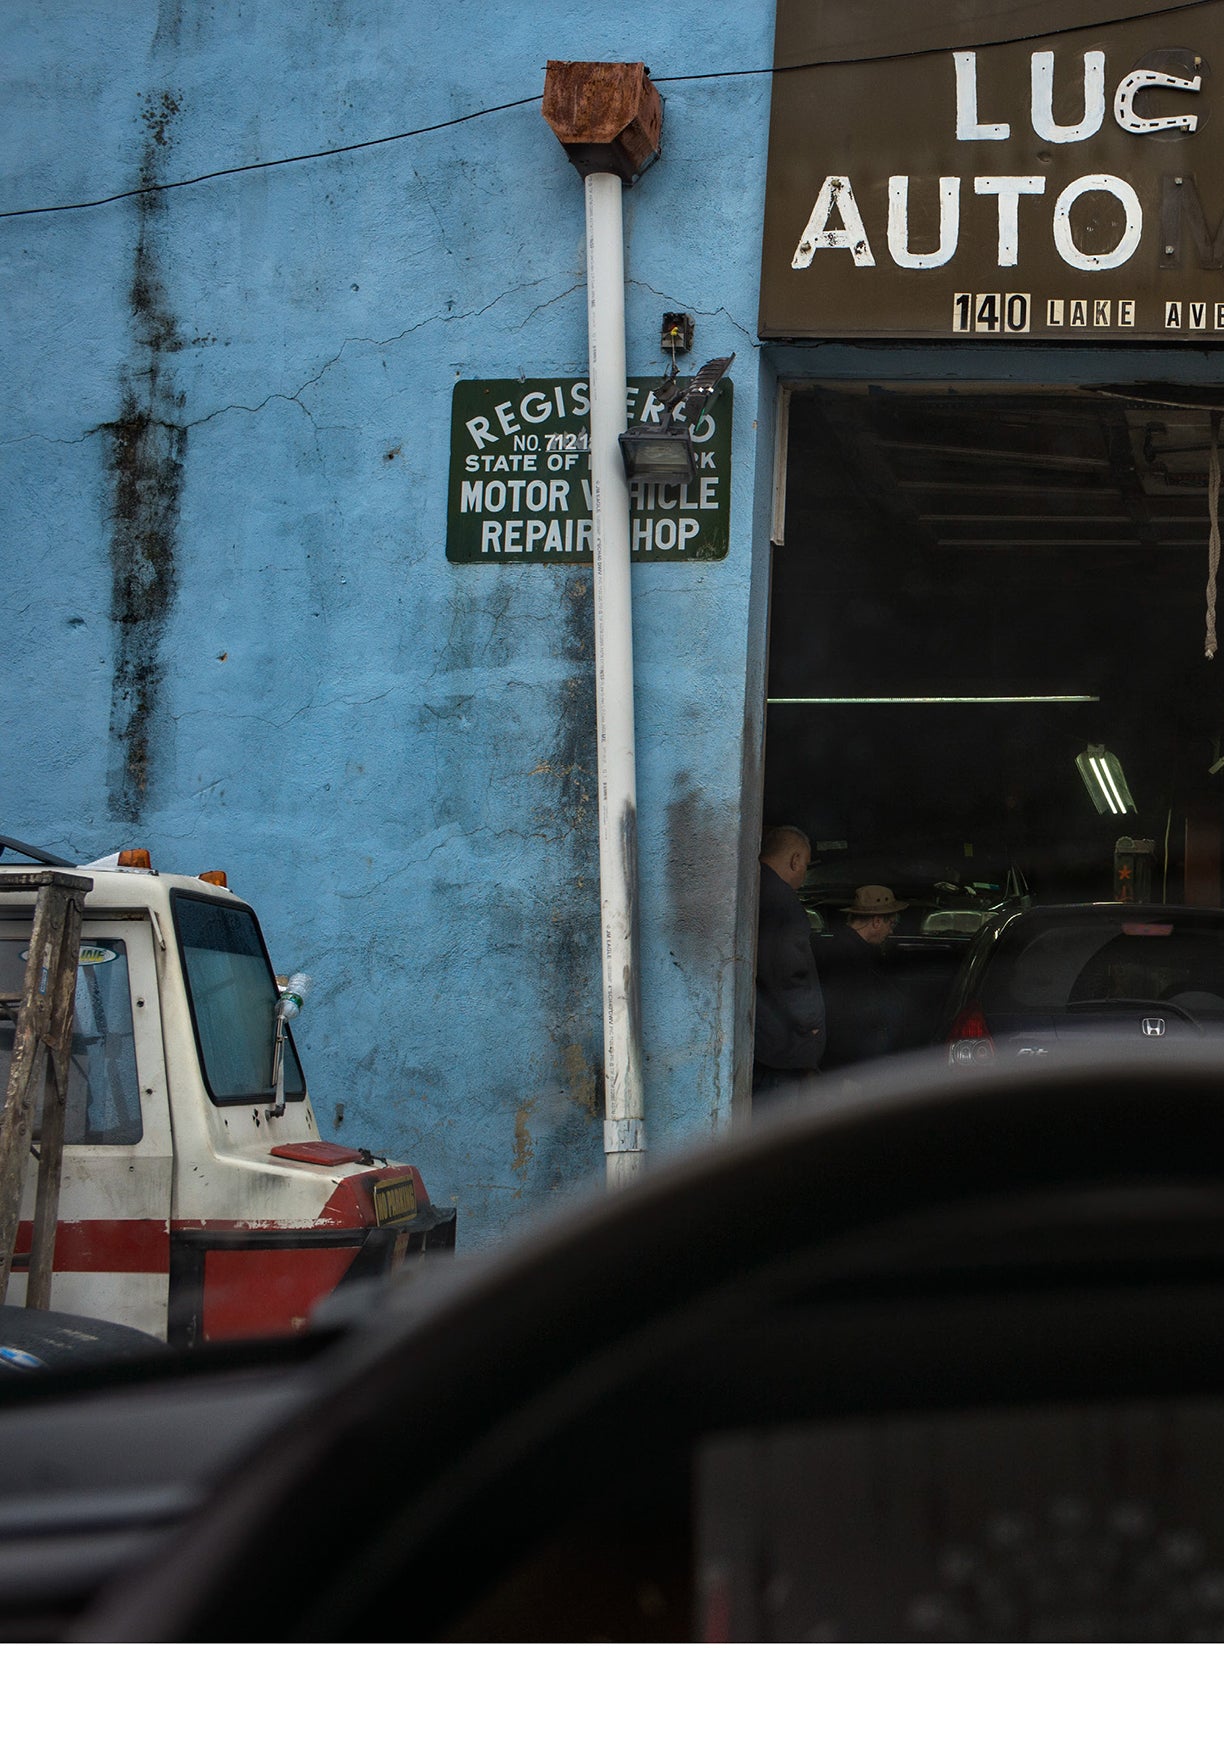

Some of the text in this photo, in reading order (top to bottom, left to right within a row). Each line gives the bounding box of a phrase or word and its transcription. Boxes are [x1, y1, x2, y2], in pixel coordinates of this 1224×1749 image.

[953, 293, 1030, 332] 140
[1048, 300, 1135, 327] LAKE
[514, 434, 541, 451] NO.
[465, 454, 537, 472] STATE
[547, 453, 579, 471] OF
[460, 479, 570, 513] MOTOR
[481, 518, 594, 553] REPAIR
[631, 517, 700, 551] HOP
